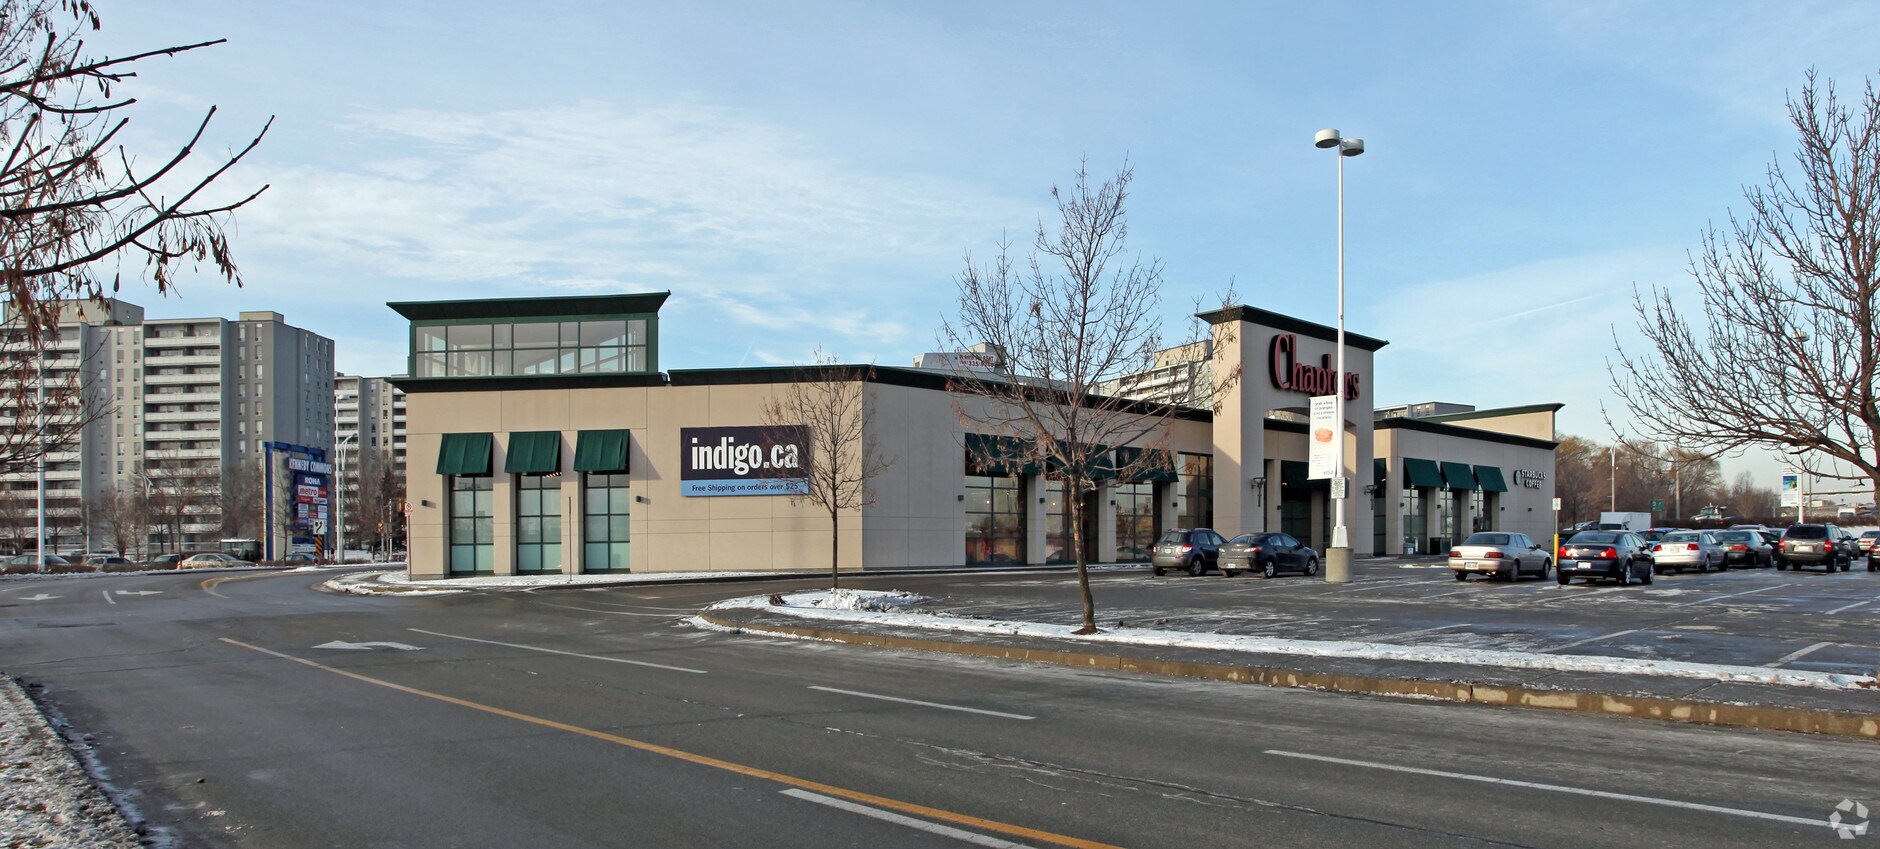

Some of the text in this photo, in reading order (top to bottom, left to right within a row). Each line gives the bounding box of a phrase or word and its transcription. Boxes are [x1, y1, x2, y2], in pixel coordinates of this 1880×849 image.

[691, 436, 799, 475] indigo.ca
[289, 458, 332, 475] KENNEDY COMMONS
[708, 484, 736, 493] Shipping
[785, 482, 799, 490] $25
[1524, 480, 1542, 489] COFFEE
[299, 488, 318, 496] metro
